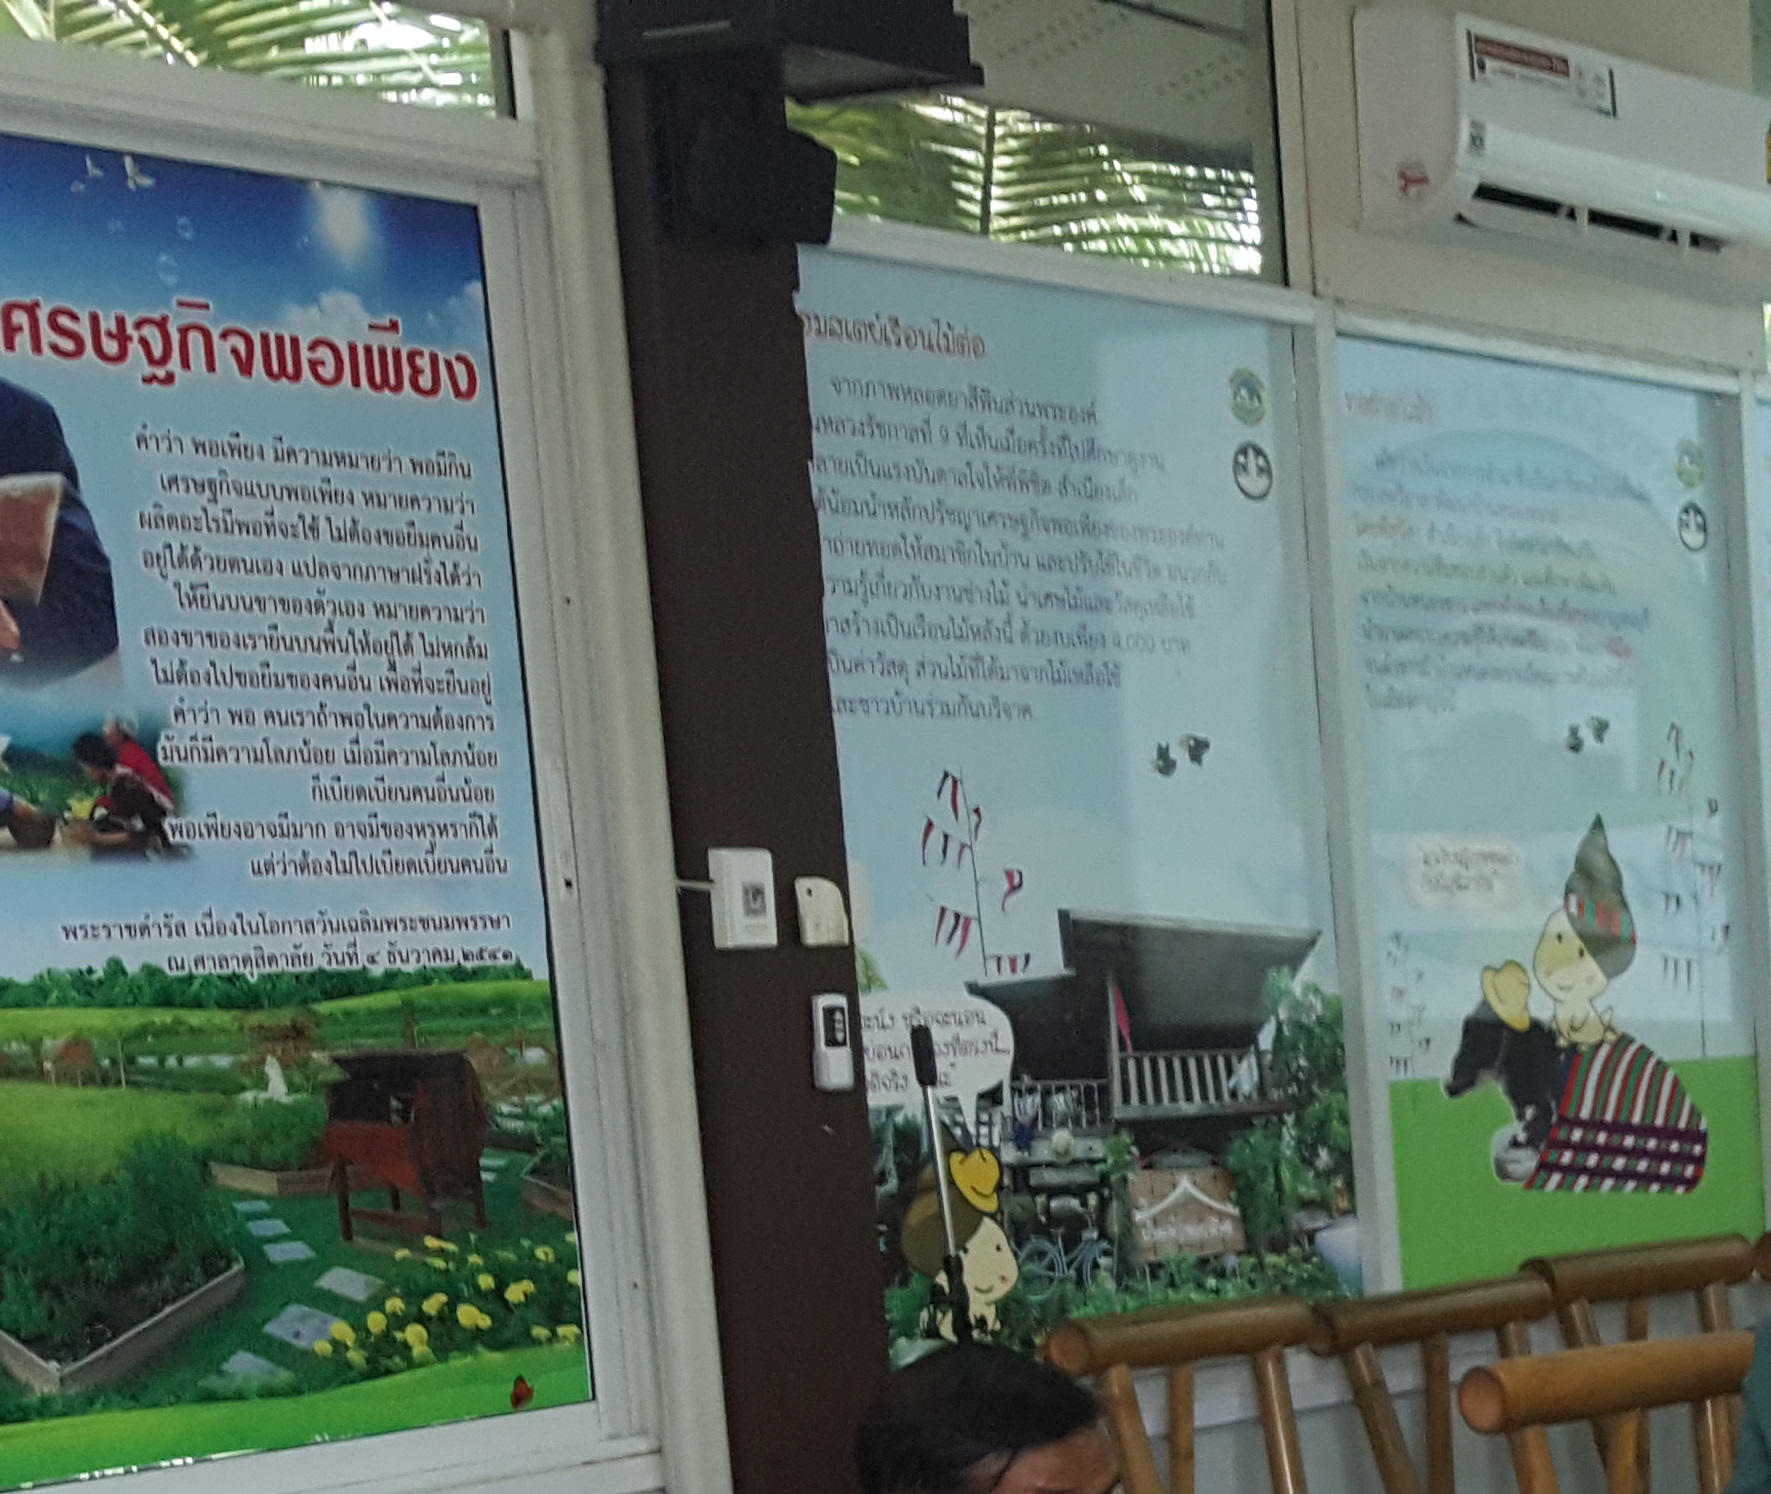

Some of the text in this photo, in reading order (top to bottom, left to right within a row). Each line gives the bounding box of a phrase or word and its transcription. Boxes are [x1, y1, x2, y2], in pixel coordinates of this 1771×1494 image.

[136, 421, 473, 481] คำว่า พอเพียง มีความหมายว่า พอมีกิน
[172, 694, 220, 726] คำว่า
[227, 706, 256, 727] พอ
